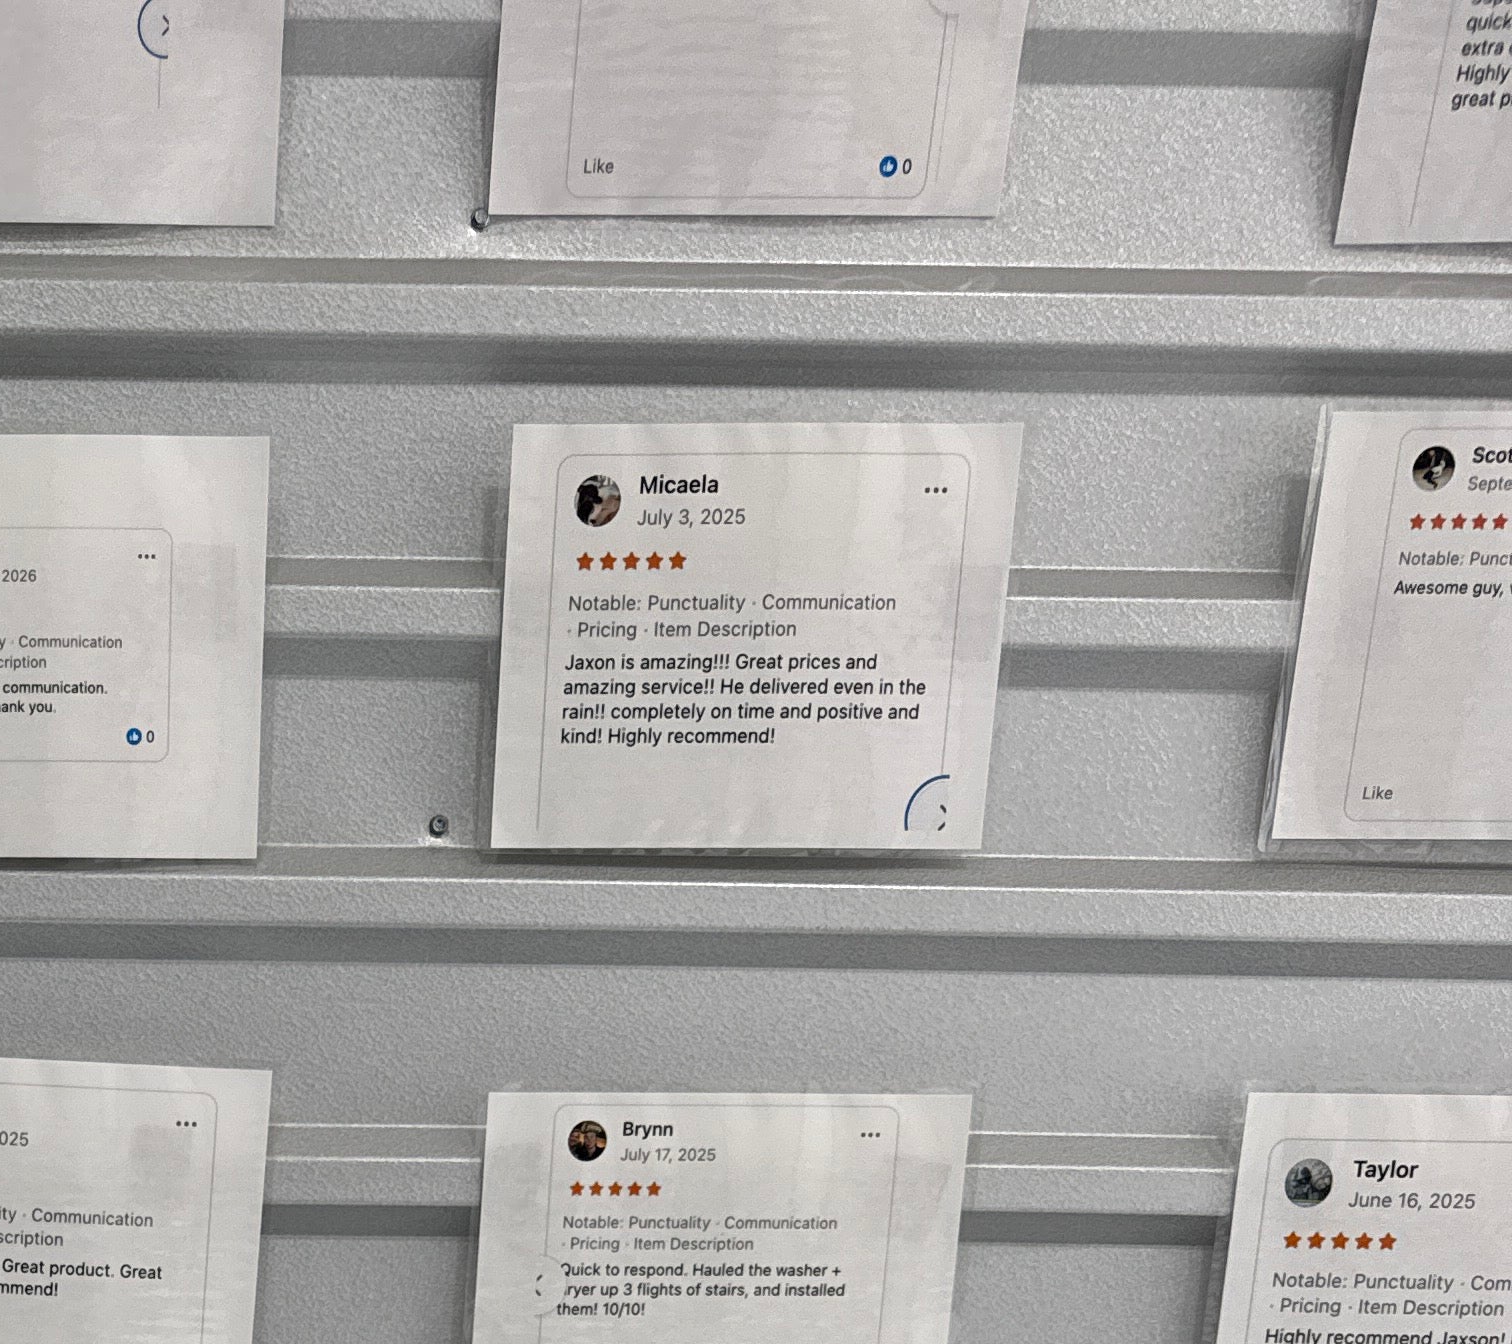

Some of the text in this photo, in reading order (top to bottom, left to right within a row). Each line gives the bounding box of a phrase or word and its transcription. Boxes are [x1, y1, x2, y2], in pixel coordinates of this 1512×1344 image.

[1466, 12, 1512, 35] quick
[1461, 40, 1505, 57] extra
[1456, 63, 1512, 86] Highly
[1451, 90, 1496, 111] great
[583, 157, 615, 175] Like
[902, 158, 913, 175] 0
[639, 473, 719, 495] Micaela
[636, 507, 746, 530] July 3, 2025
[1398, 550, 1466, 567] Notable:
[1, 568, 37, 583] 2026
[1393, 579, 1504, 599] Awesome guy,
[18, 634, 123, 649] Communication
[564, 653, 878, 674] Jaxon is amazing!!! Great prices and
[2, 680, 108, 695] communication.
[28, 702, 57, 717] you.
[145, 729, 155, 744] 0
[1362, 785, 1394, 800] Like
[622, 1121, 674, 1140] Brynn
[619, 1147, 717, 1165] July 17, 2025
[1353, 1159, 1419, 1183] Taylor
[1347, 1191, 1476, 1213] June 16, 2025
[1, 1258, 45, 1275] Great
[48, 1261, 115, 1278] product.
[119, 1263, 162, 1280] Great
[563, 1282, 846, 1300] ryer up 3 flights of stairs, and installed
[556, 1302, 646, 1319] them! 10/10!
[1279, 1296, 1505, 1320] Pricing Item Description
